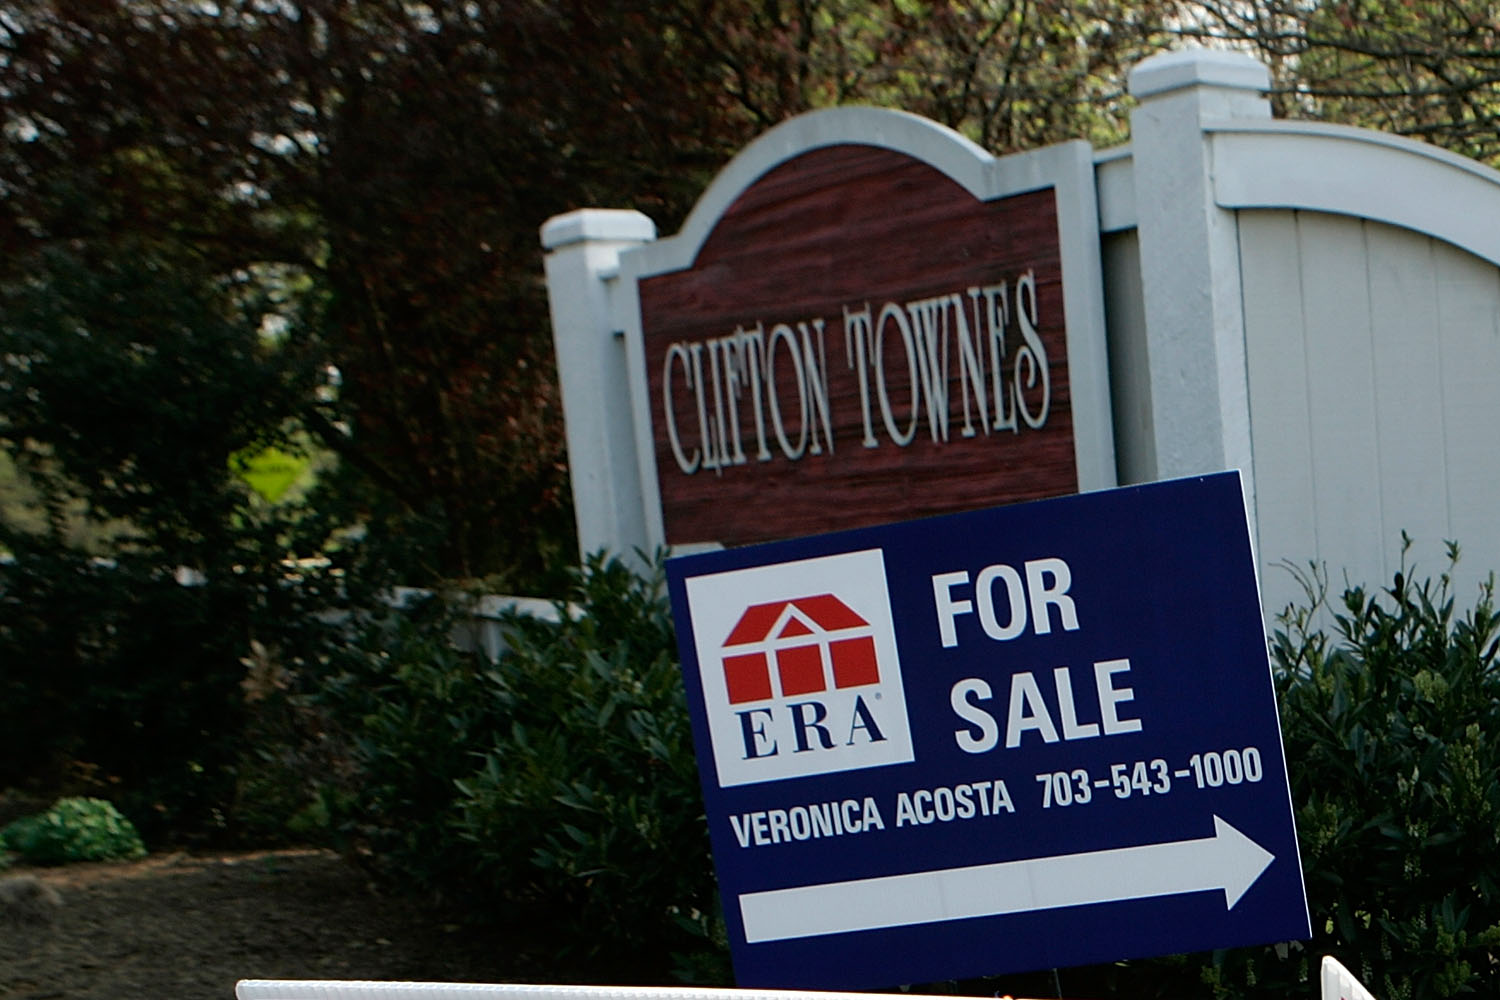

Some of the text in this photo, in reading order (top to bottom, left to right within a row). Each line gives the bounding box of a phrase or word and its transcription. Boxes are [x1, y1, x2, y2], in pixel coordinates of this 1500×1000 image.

[664, 268, 1050, 477] CLIFTON TOWNES
[932, 557, 1079, 648] FOR
[735, 694, 887, 761] ERA
[950, 658, 1143, 753] SALE
[730, 747, 1263, 848] VERONICA ACOSTA 703-543-1000
